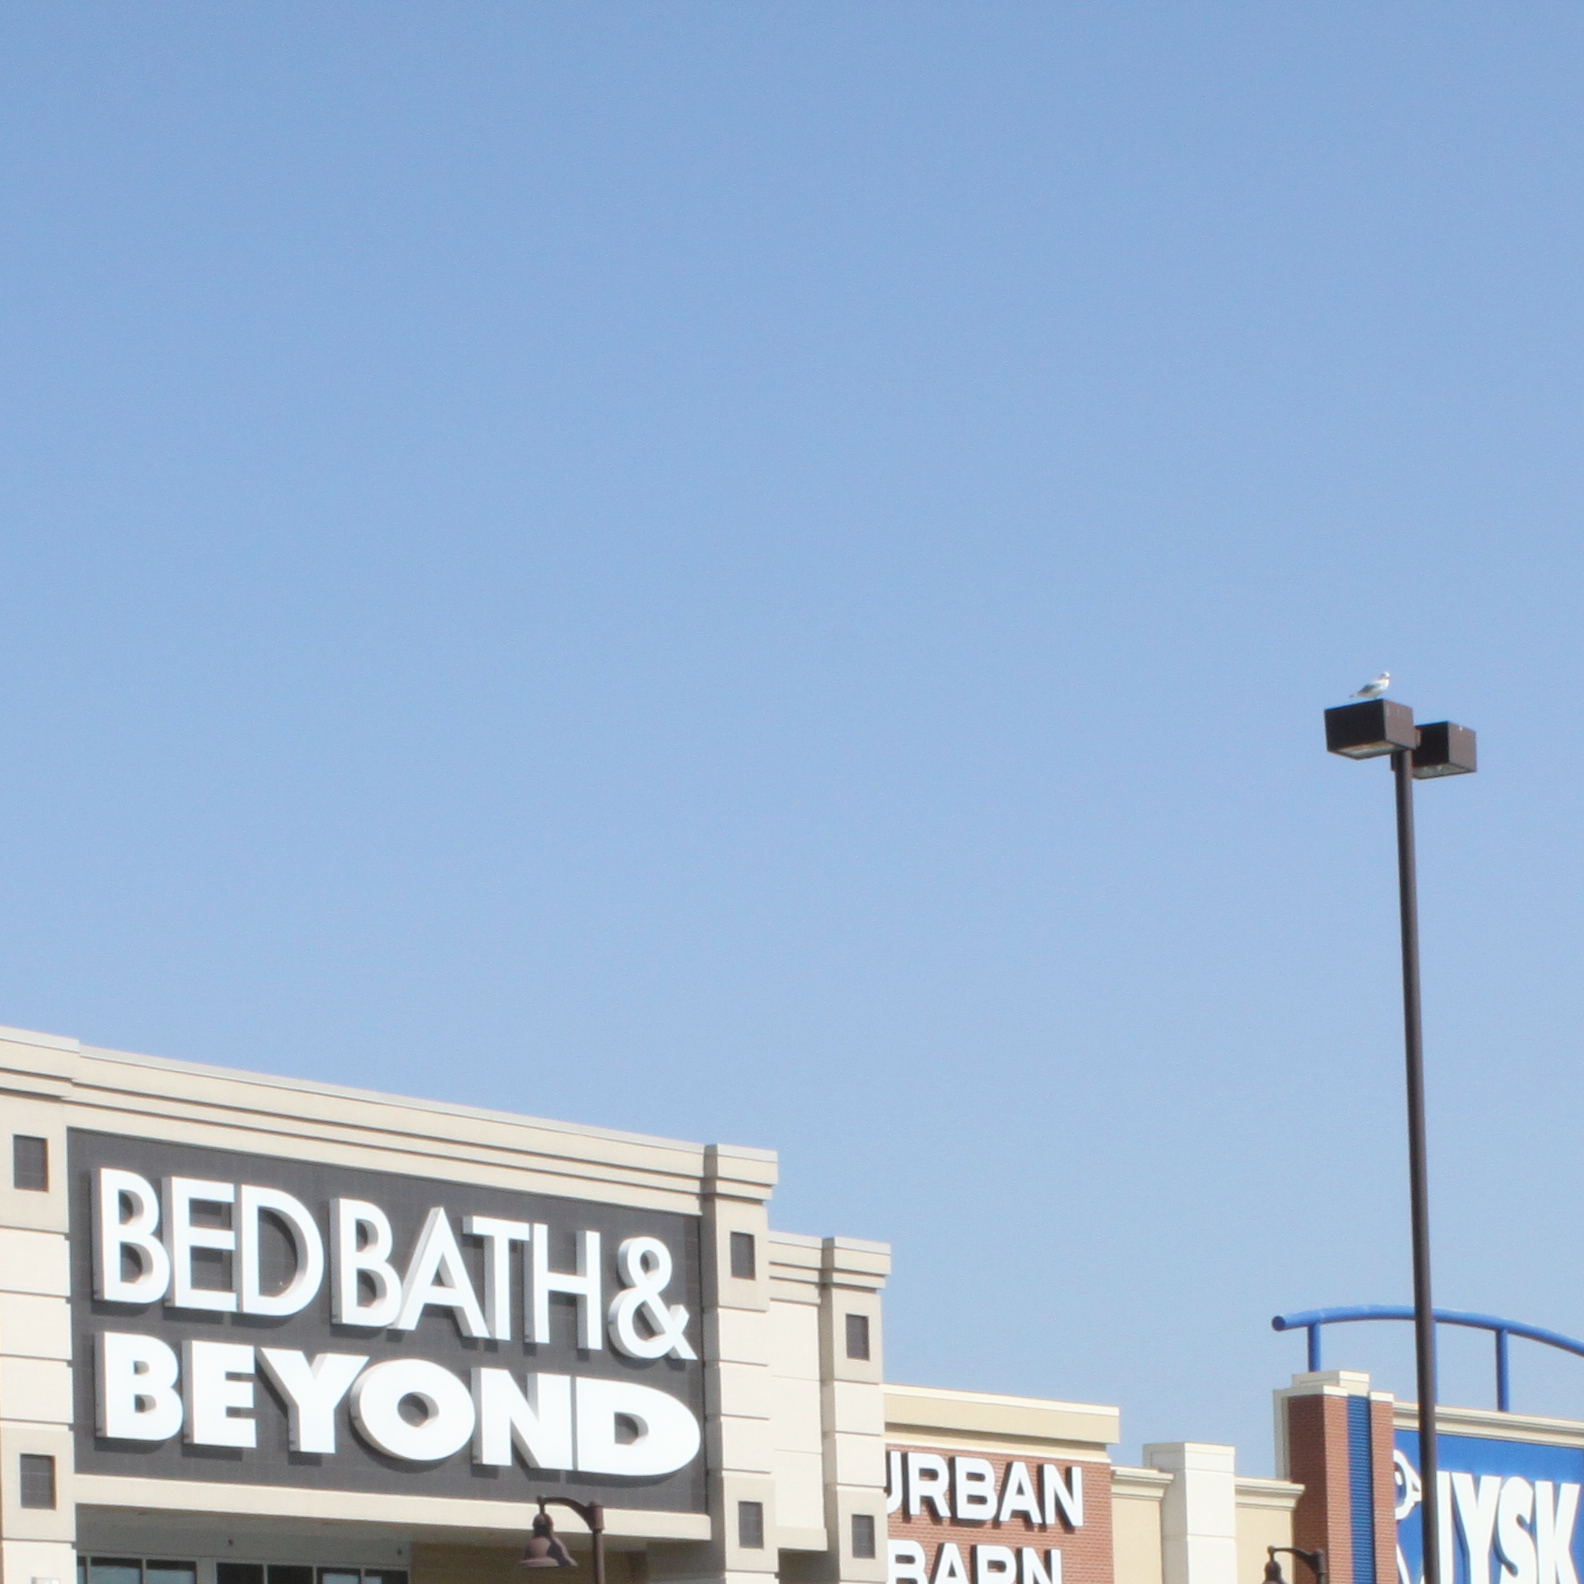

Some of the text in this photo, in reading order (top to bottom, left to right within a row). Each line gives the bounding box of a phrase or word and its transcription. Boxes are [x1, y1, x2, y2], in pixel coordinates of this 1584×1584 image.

[91, 1167, 698, 1360] BED BATH &
[94, 1331, 702, 1477] BEYOND
